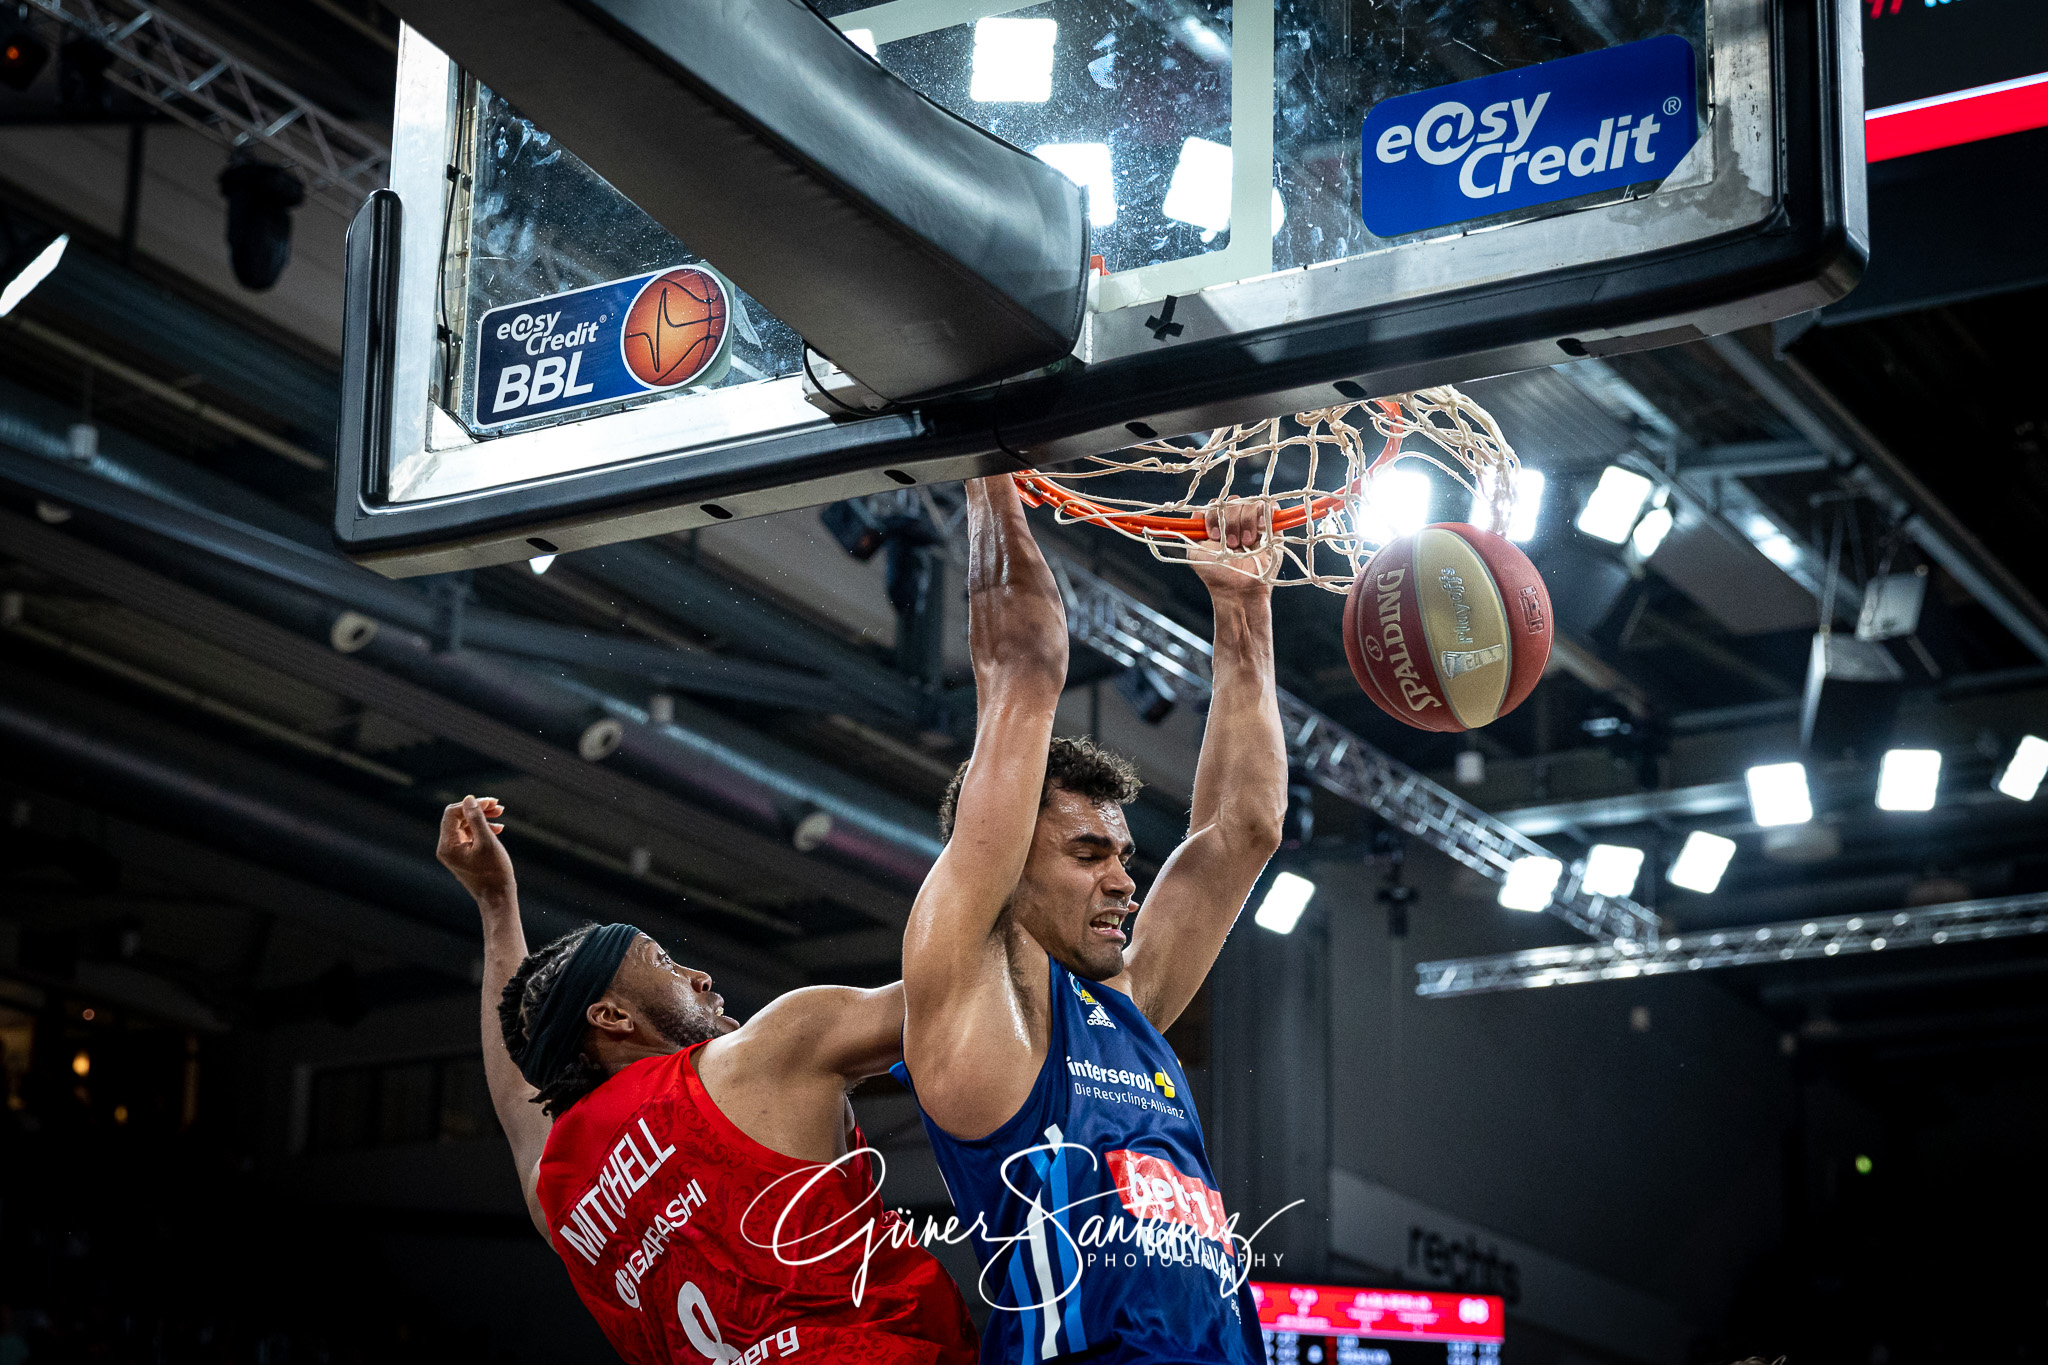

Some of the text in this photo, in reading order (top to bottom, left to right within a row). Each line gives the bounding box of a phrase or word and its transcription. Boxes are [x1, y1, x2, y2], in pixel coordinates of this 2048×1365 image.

[492, 351, 594, 413] BBL
[1439, 567, 1474, 644] Playoffs
[1377, 568, 1443, 712] SPALDING
[1066, 1056, 1156, 1093] interseroh
[1074, 1083, 1185, 1120] Die Recycling-Allianz
